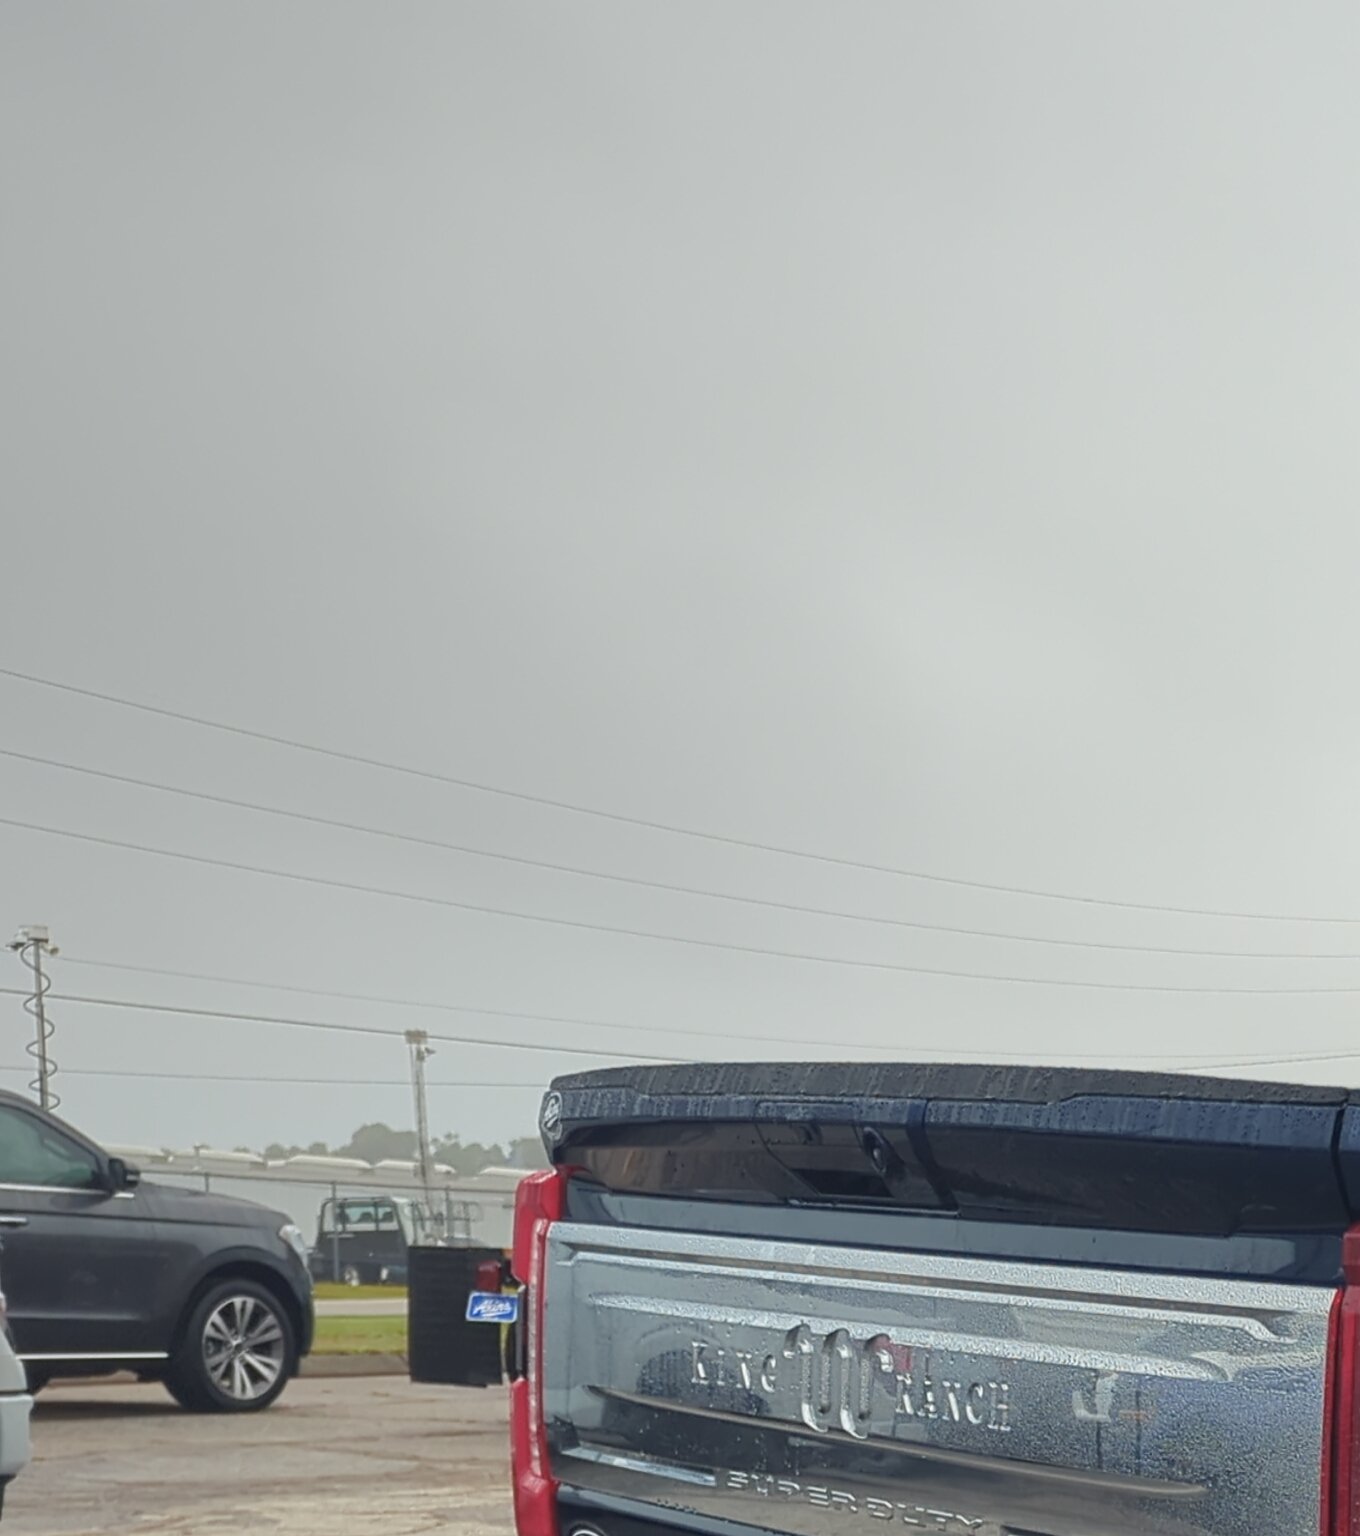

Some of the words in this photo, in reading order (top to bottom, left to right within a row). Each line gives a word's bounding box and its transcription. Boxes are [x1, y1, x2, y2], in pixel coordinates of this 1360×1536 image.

[691, 1341, 776, 1393] KING
[896, 1372, 1011, 1431] RANCH
[727, 1470, 858, 1513] SUPER
[867, 1497, 984, 1536] DUTY
